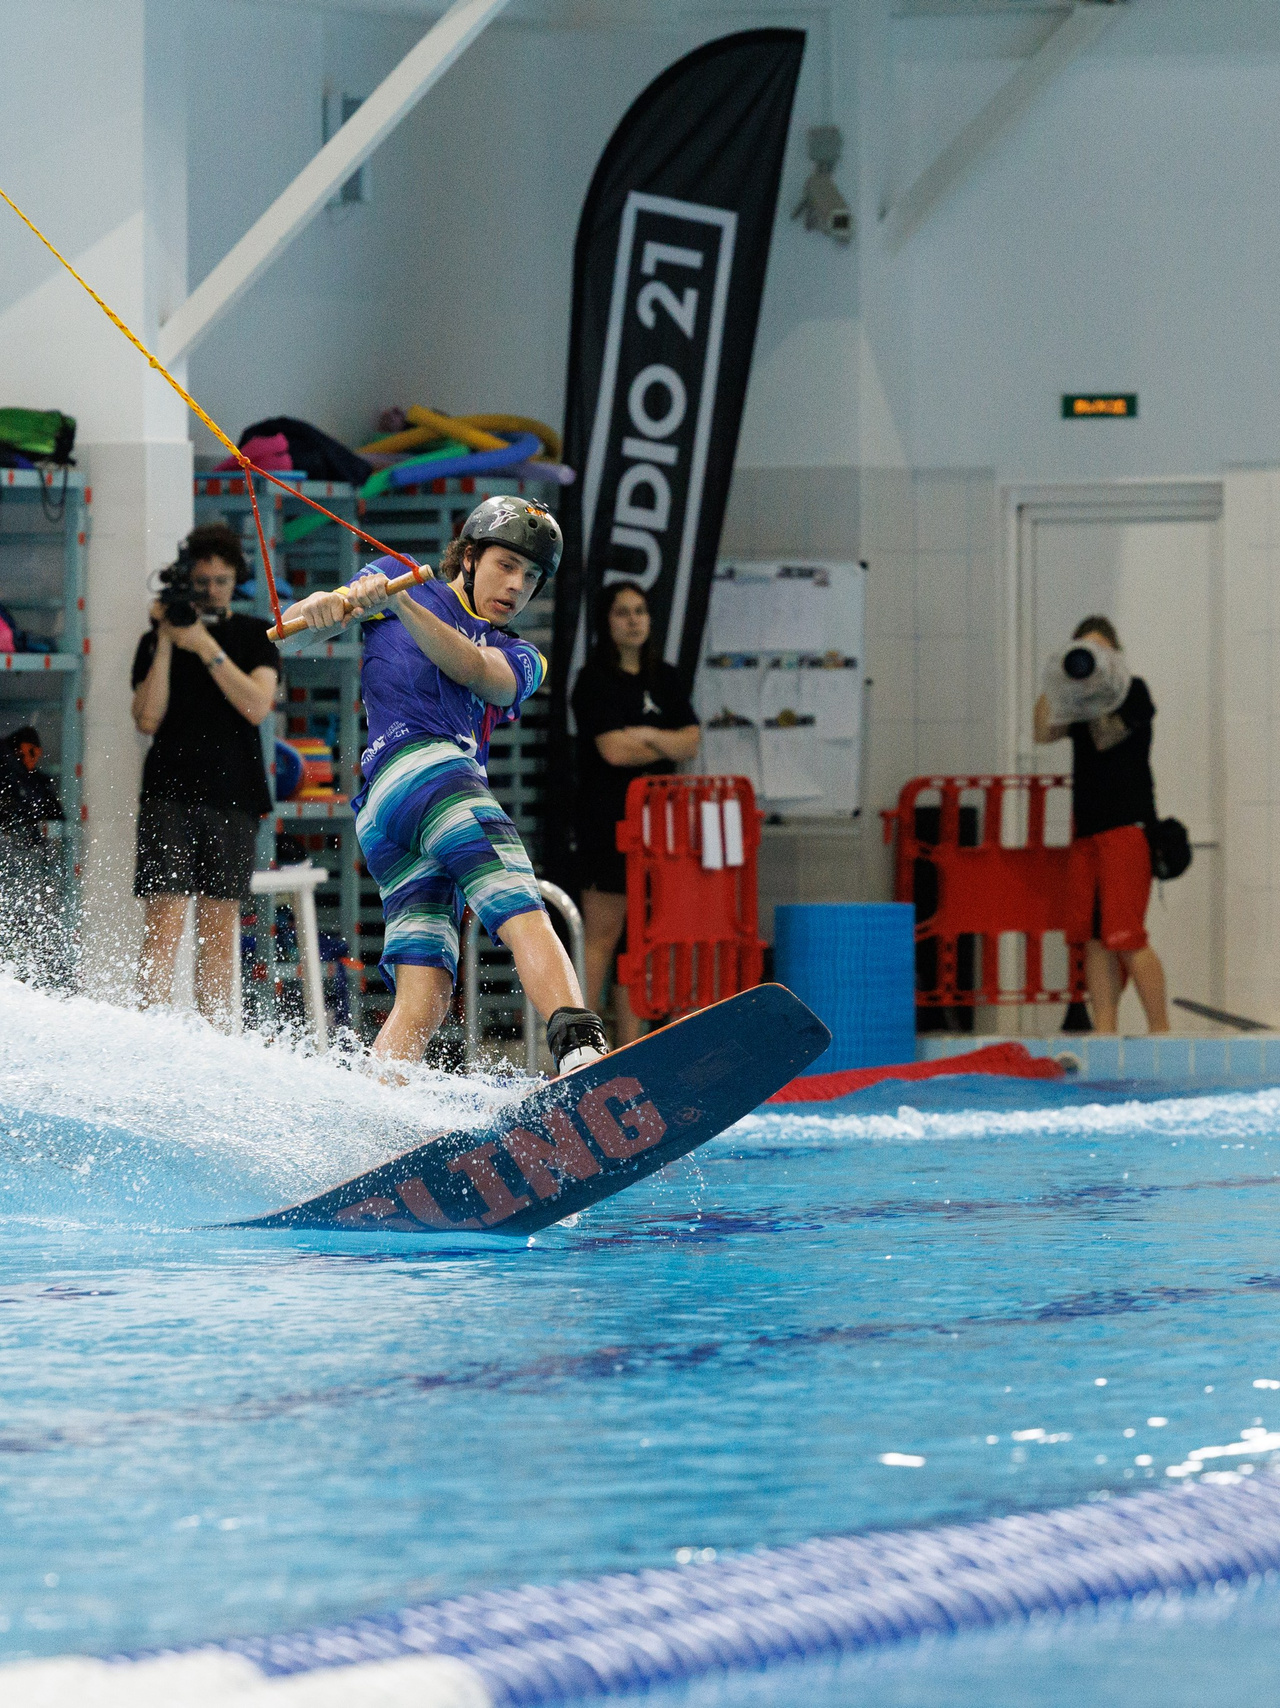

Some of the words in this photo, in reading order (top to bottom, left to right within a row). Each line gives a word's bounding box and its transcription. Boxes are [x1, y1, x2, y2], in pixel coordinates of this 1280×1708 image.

[637, 241, 703, 339] 21
[603, 364, 687, 590] UDIO
[332, 1076, 667, 1230] SLING
